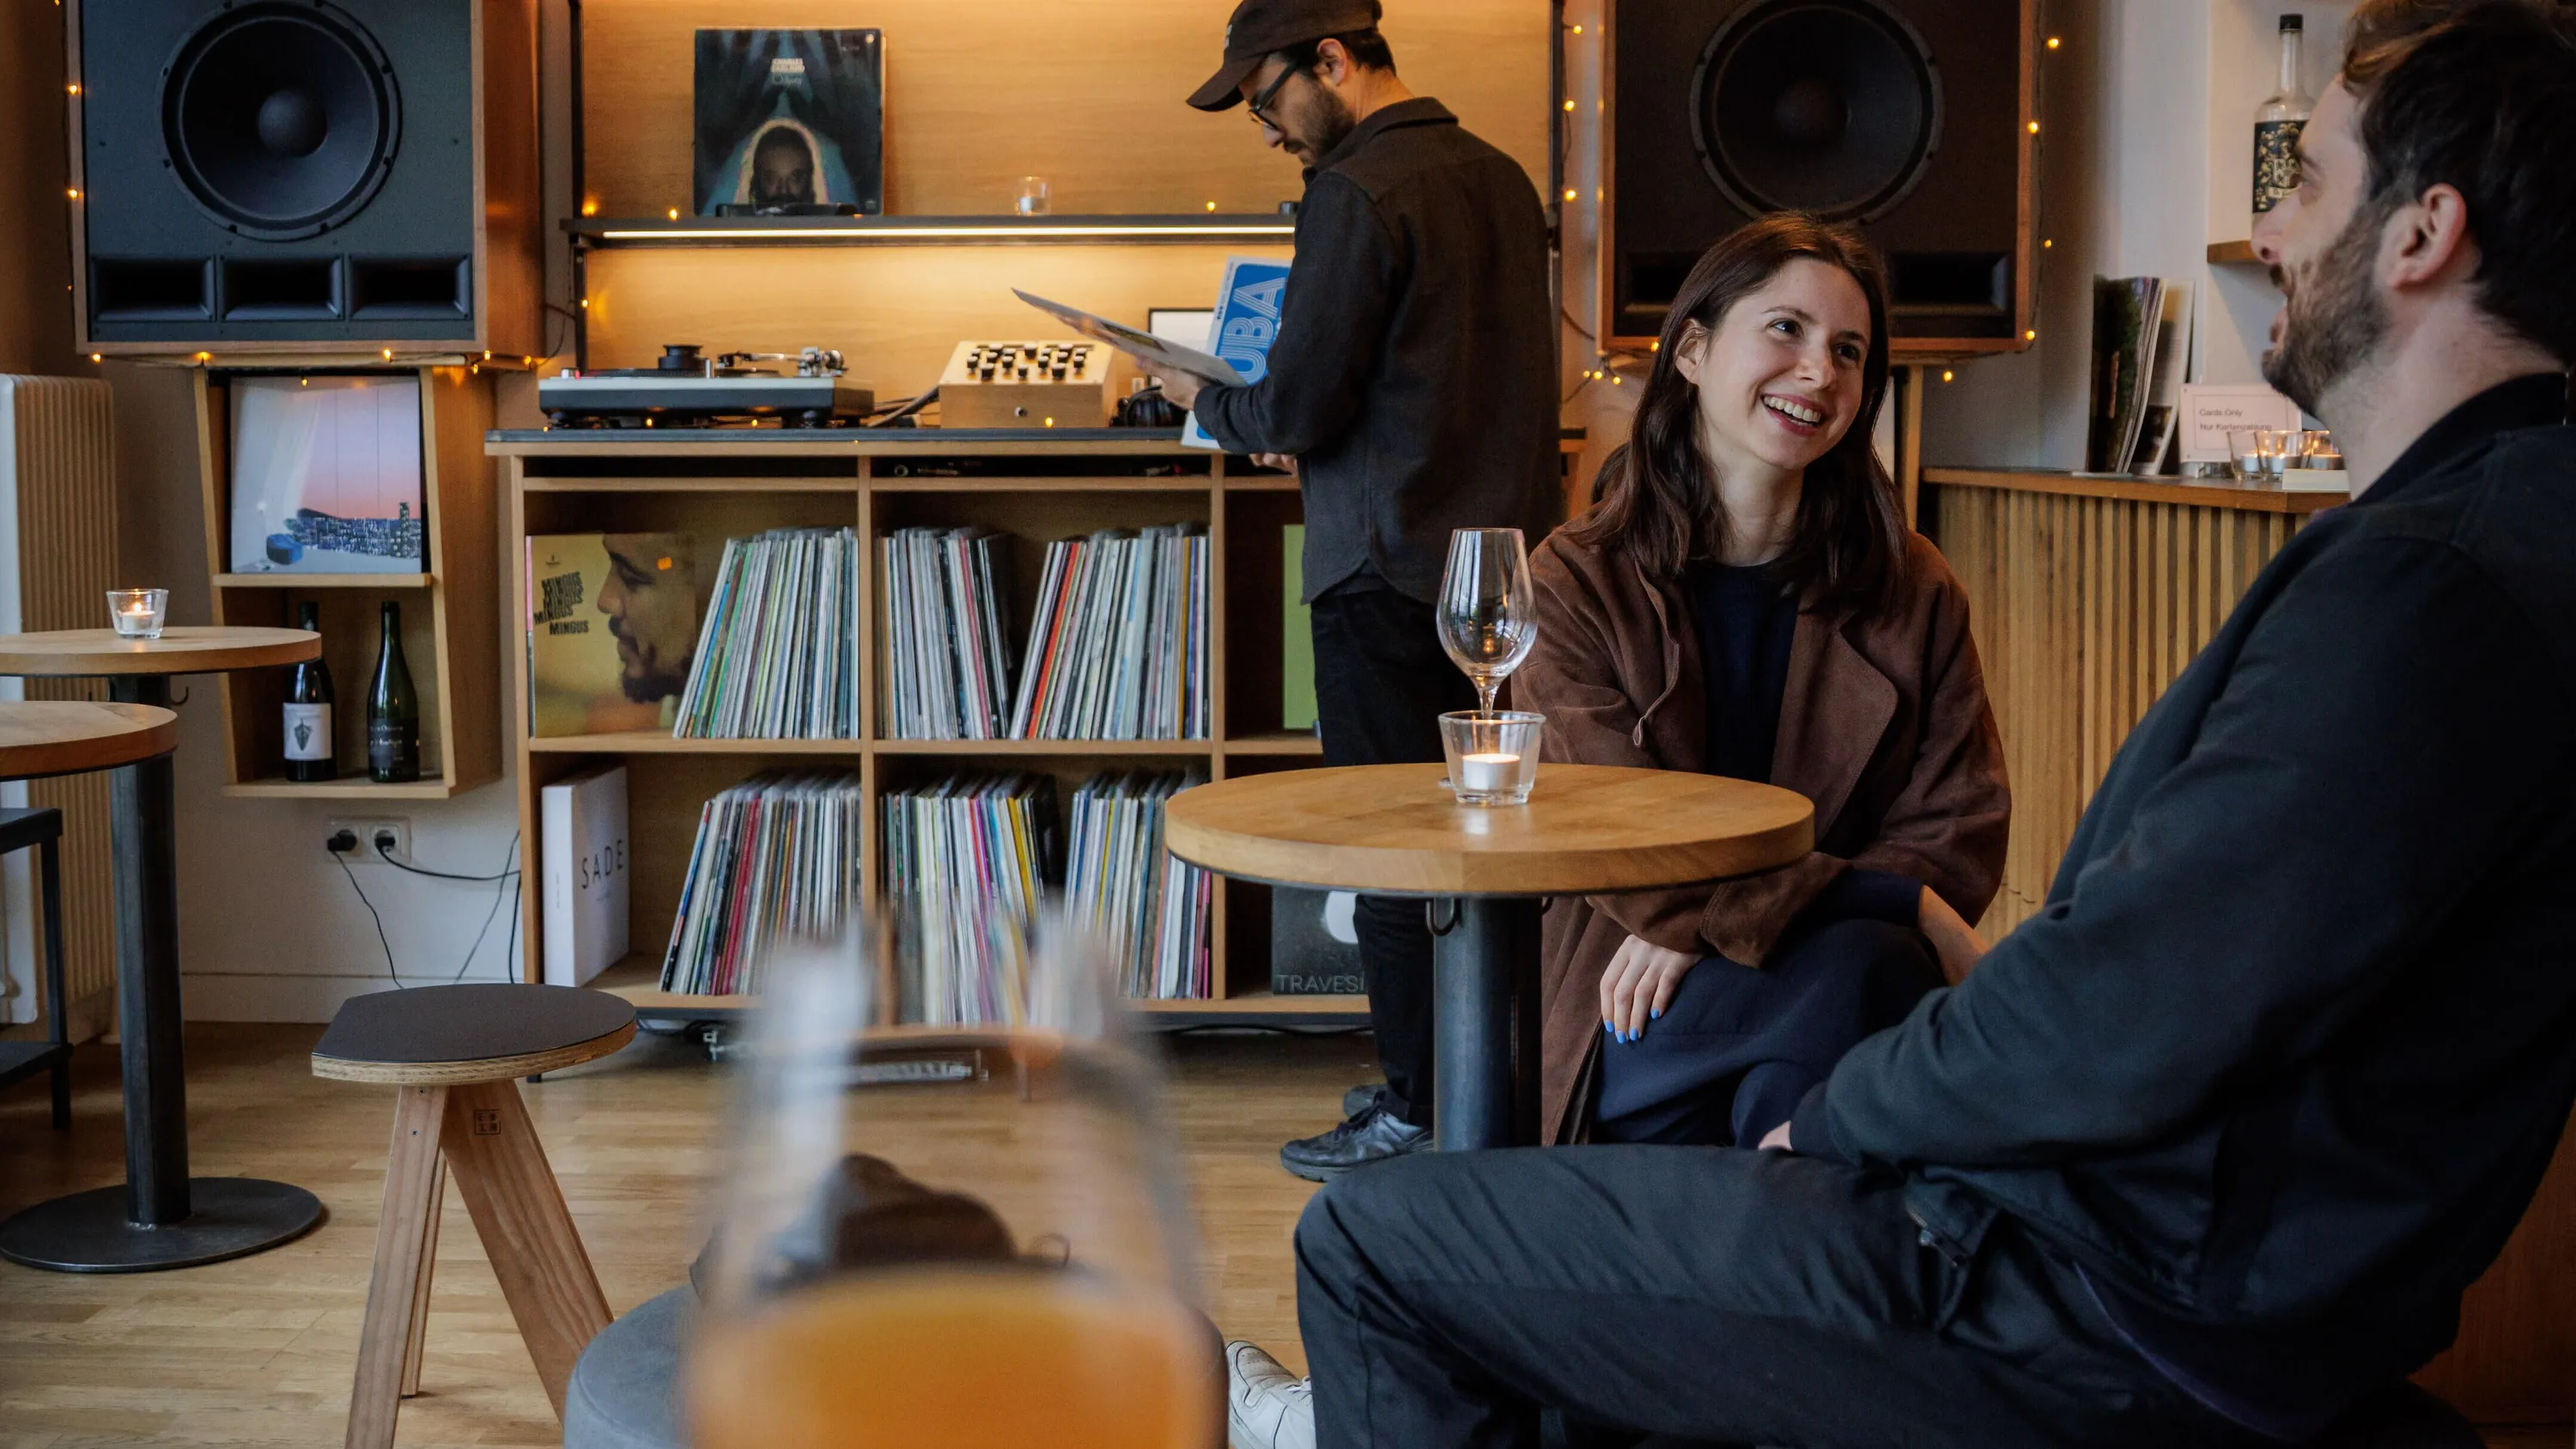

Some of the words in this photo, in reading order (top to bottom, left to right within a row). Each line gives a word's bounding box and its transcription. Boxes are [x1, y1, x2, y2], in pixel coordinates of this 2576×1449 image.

[1219, 277, 1285, 387] UBA
[2199, 408, 2223, 417] Cards
[2224, 408, 2243, 418] Only
[2216, 423, 2272, 432] Kartenzahlung
[550, 619, 589, 635] MINGUS
[581, 839, 623, 890] SADE
